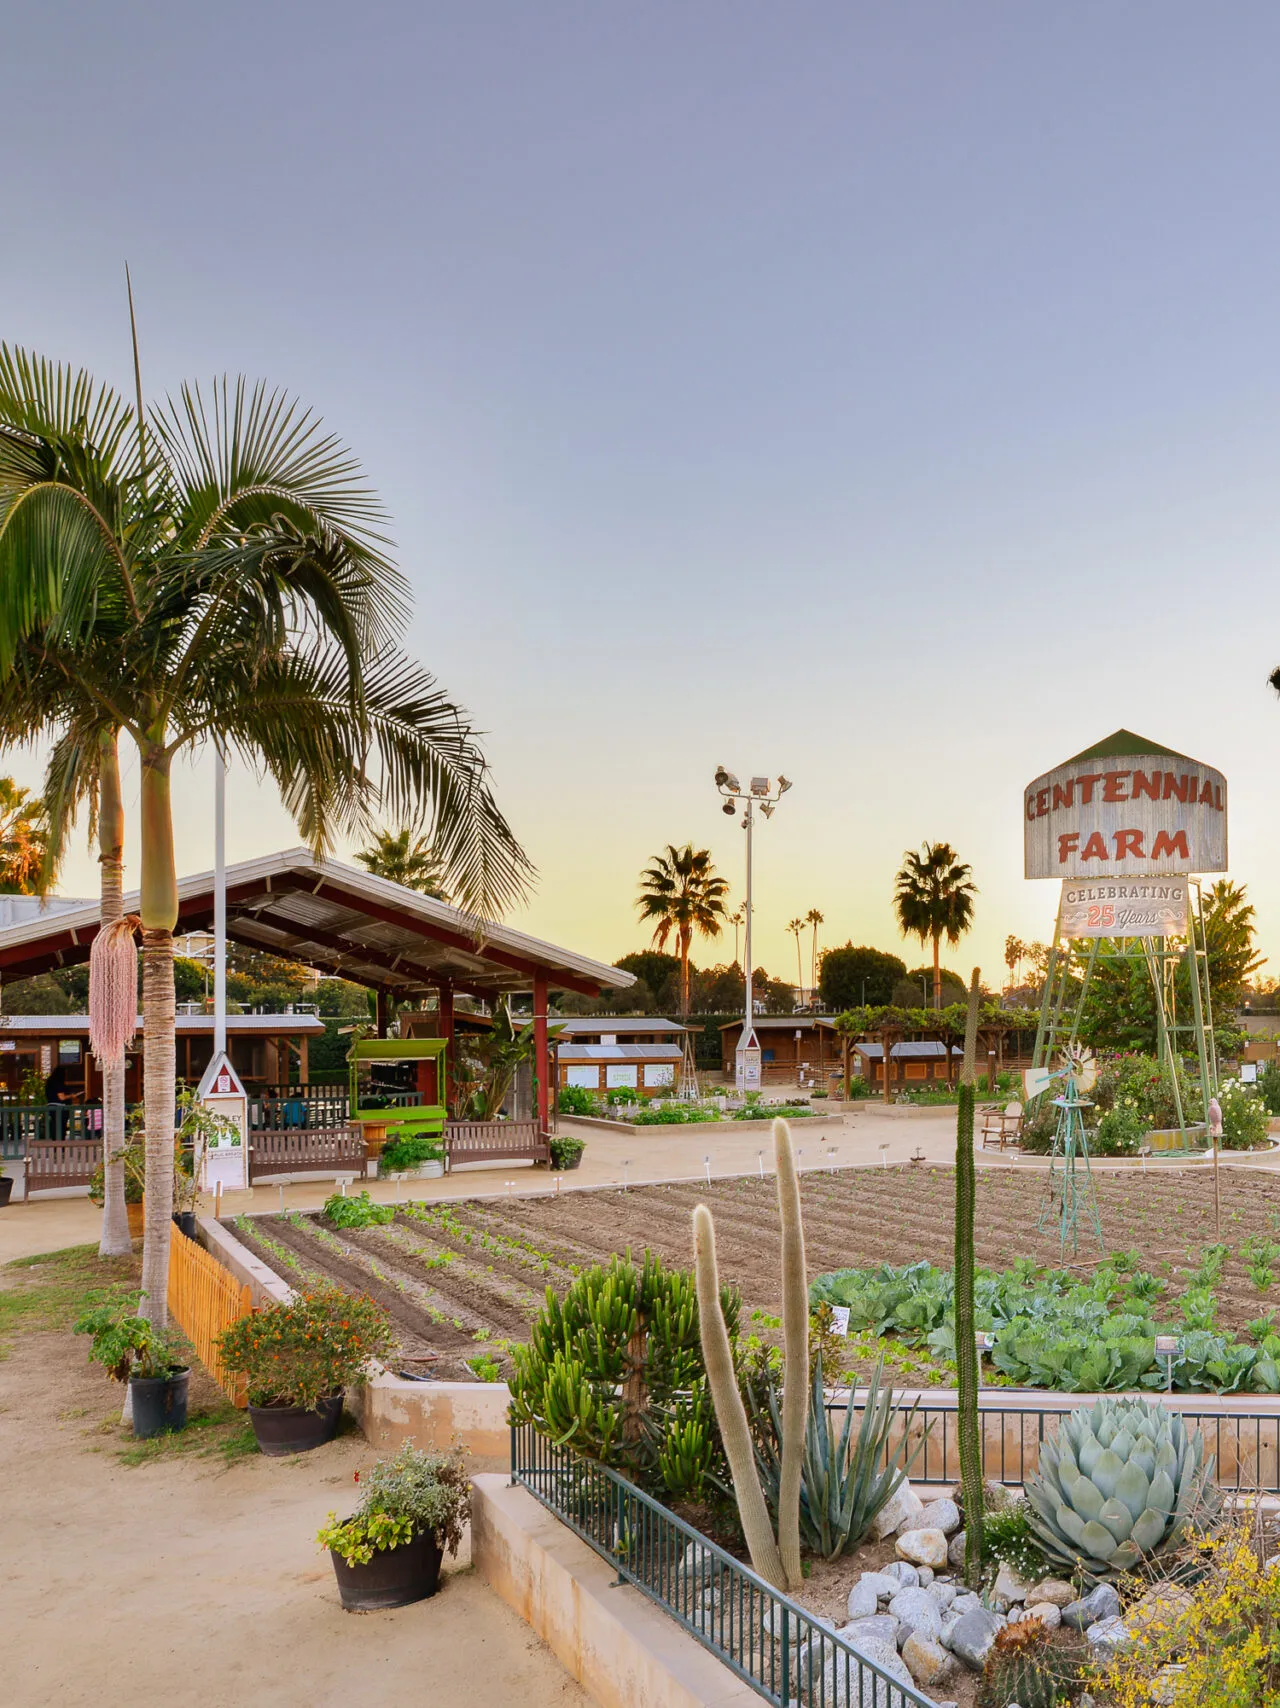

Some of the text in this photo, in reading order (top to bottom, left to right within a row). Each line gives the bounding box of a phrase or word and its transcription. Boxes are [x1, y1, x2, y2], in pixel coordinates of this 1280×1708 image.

[1026, 769, 1224, 821] CENTENNIAL
[1058, 828, 1190, 863] FARM
[1066, 886, 1182, 904] CELEBRATING
[1087, 905, 1158, 929] 25 Years
